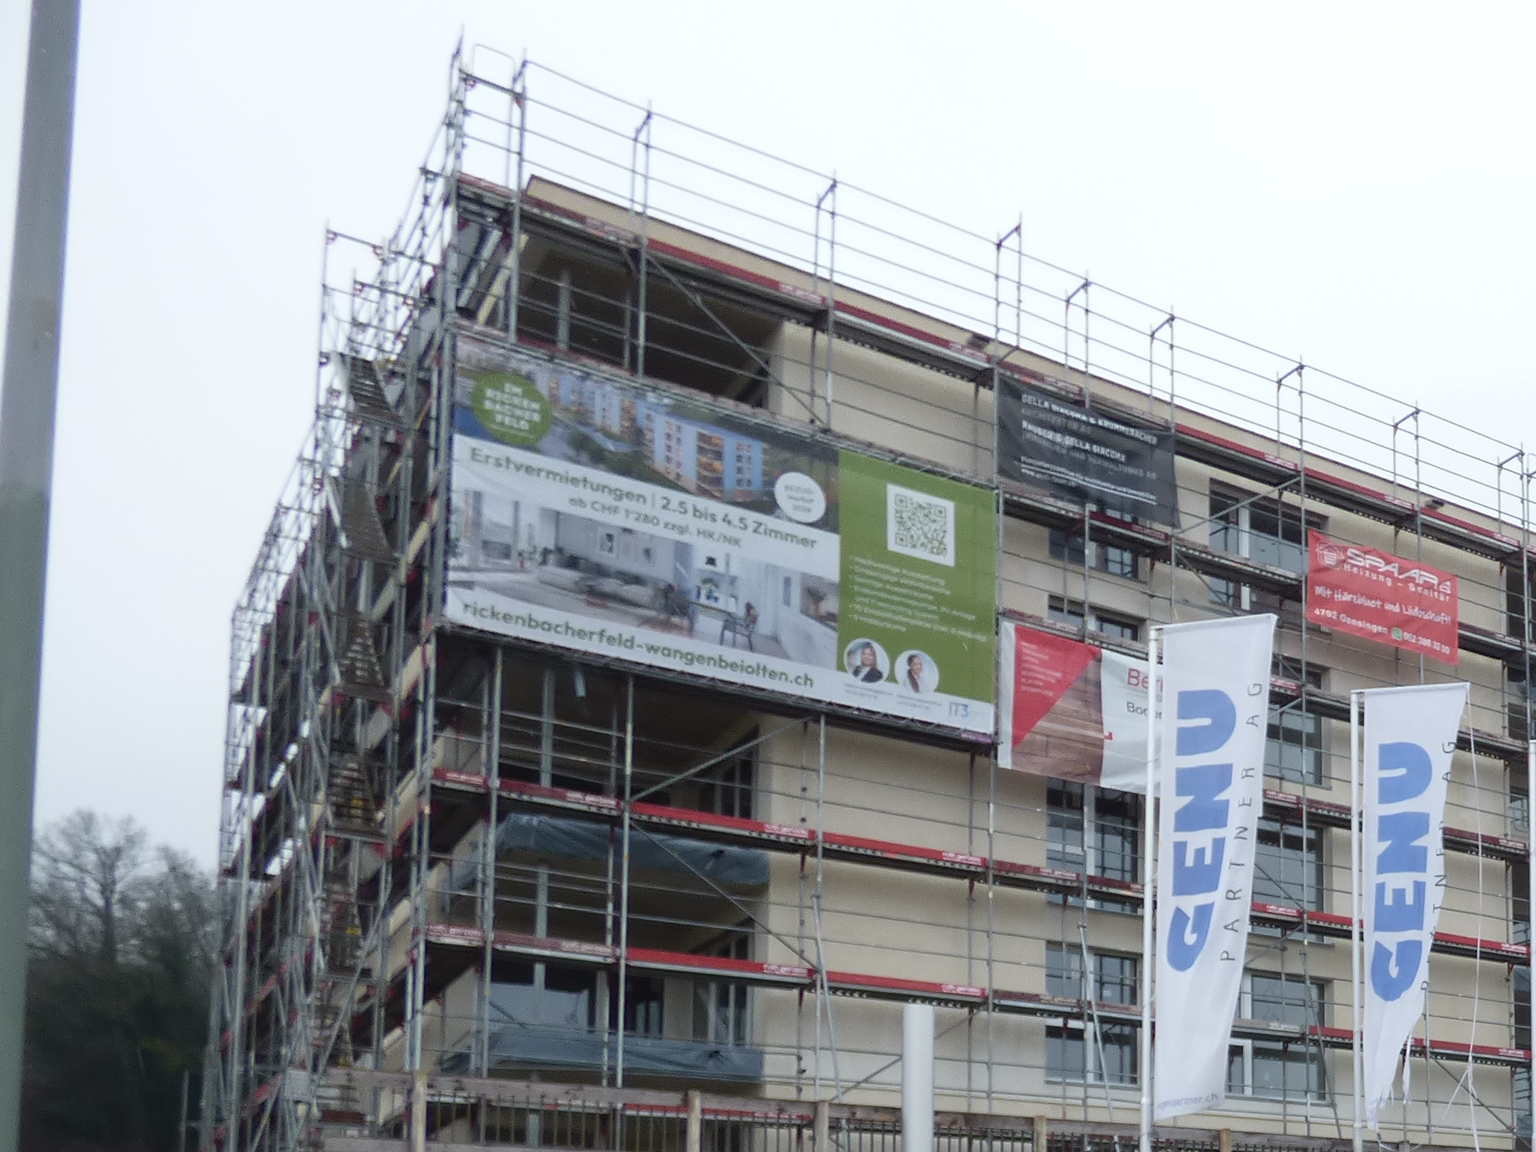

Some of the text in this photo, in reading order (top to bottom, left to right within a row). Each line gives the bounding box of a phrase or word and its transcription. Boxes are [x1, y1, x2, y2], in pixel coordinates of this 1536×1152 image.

[470, 447, 648, 505] Erstvermietungen
[661, 495, 688, 515] 2.5
[693, 505, 718, 524] bis
[722, 513, 749, 532] 4.5
[752, 520, 818, 549] Zimmer
[568, 497, 587, 509] ab
[1343, 563, 1393, 587] Heizung
[461, 601, 815, 690] rickenbacherfeld-wangenbeiolten.ch
[1166, 689, 1236, 972] GENU
[1220, 682, 1263, 963] PARTNER AG
[1370, 742, 1433, 1001] GENU
